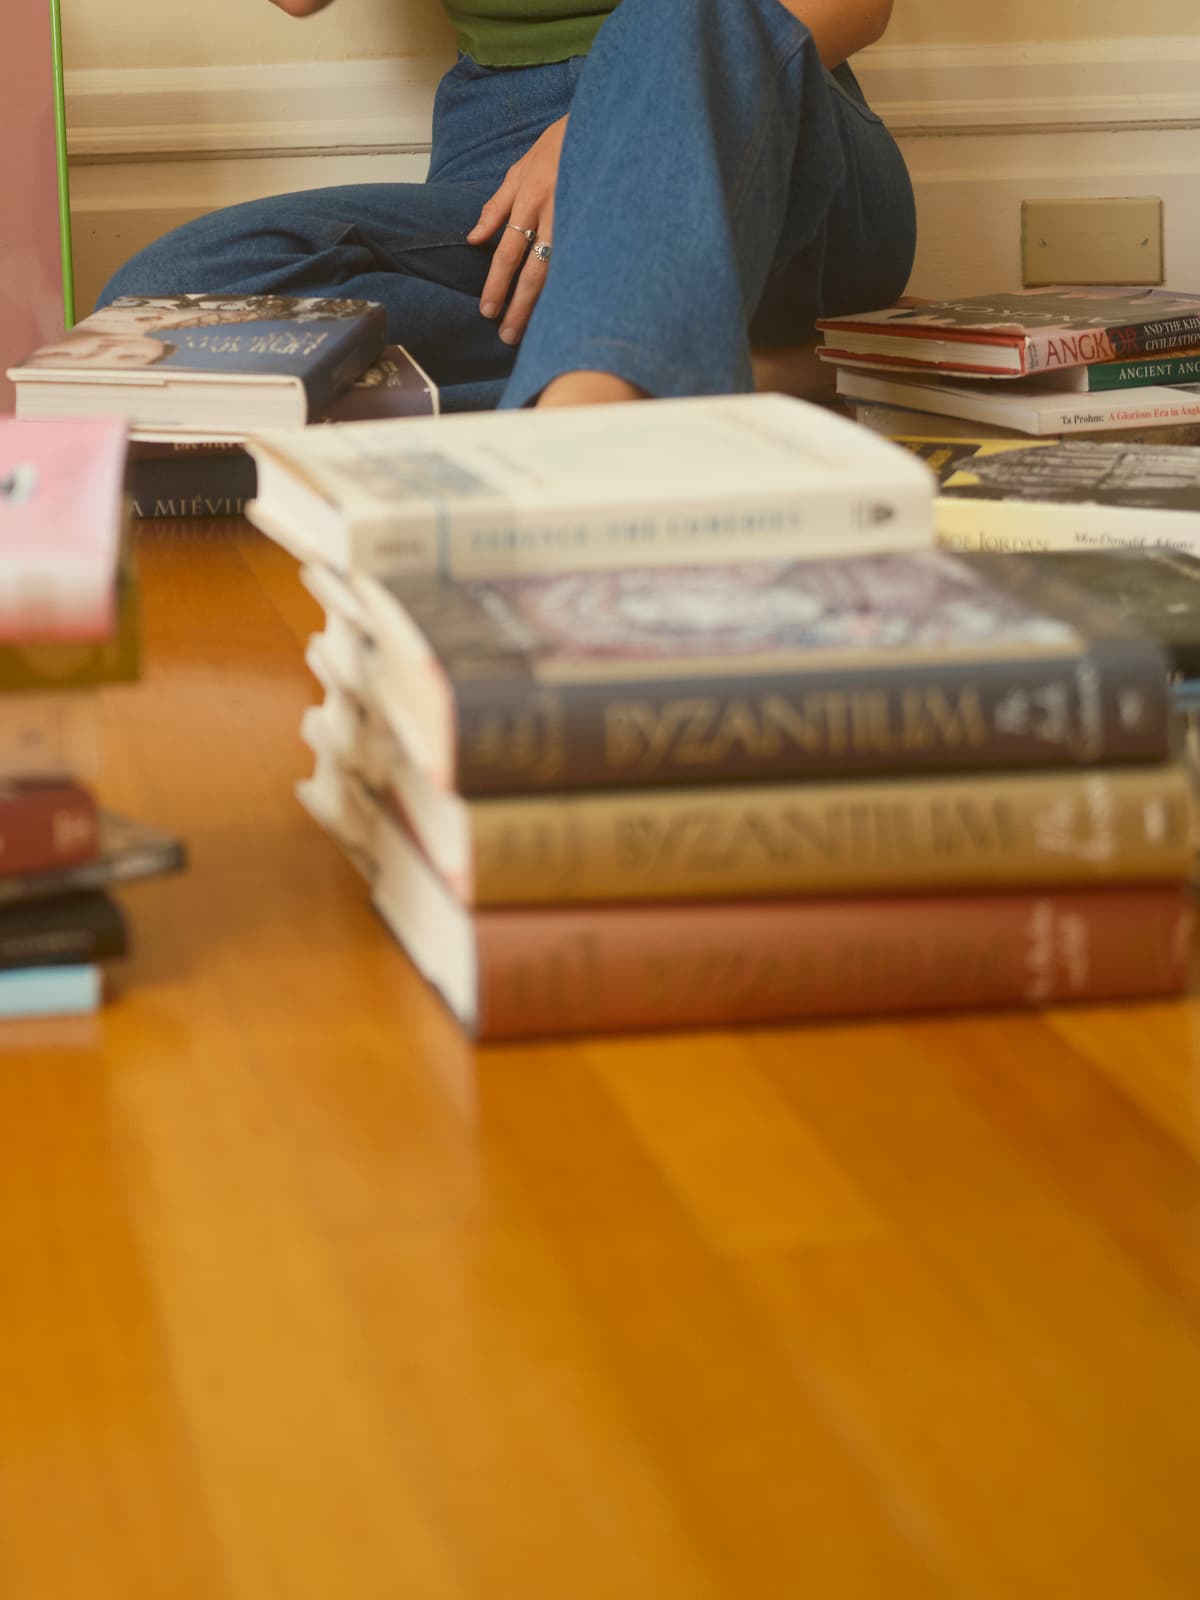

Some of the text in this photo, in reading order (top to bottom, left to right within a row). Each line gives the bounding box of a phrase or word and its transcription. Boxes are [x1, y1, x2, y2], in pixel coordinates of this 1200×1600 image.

[1046, 327, 1141, 367] ANGKOR
[1144, 323, 1163, 337] AND
[1163, 319, 1183, 333] THE
[1119, 363, 1173, 381] ANCIENT
[603, 685, 987, 771] BYZANTIUM
[611, 795, 1018, 876] BYZANTIUM
